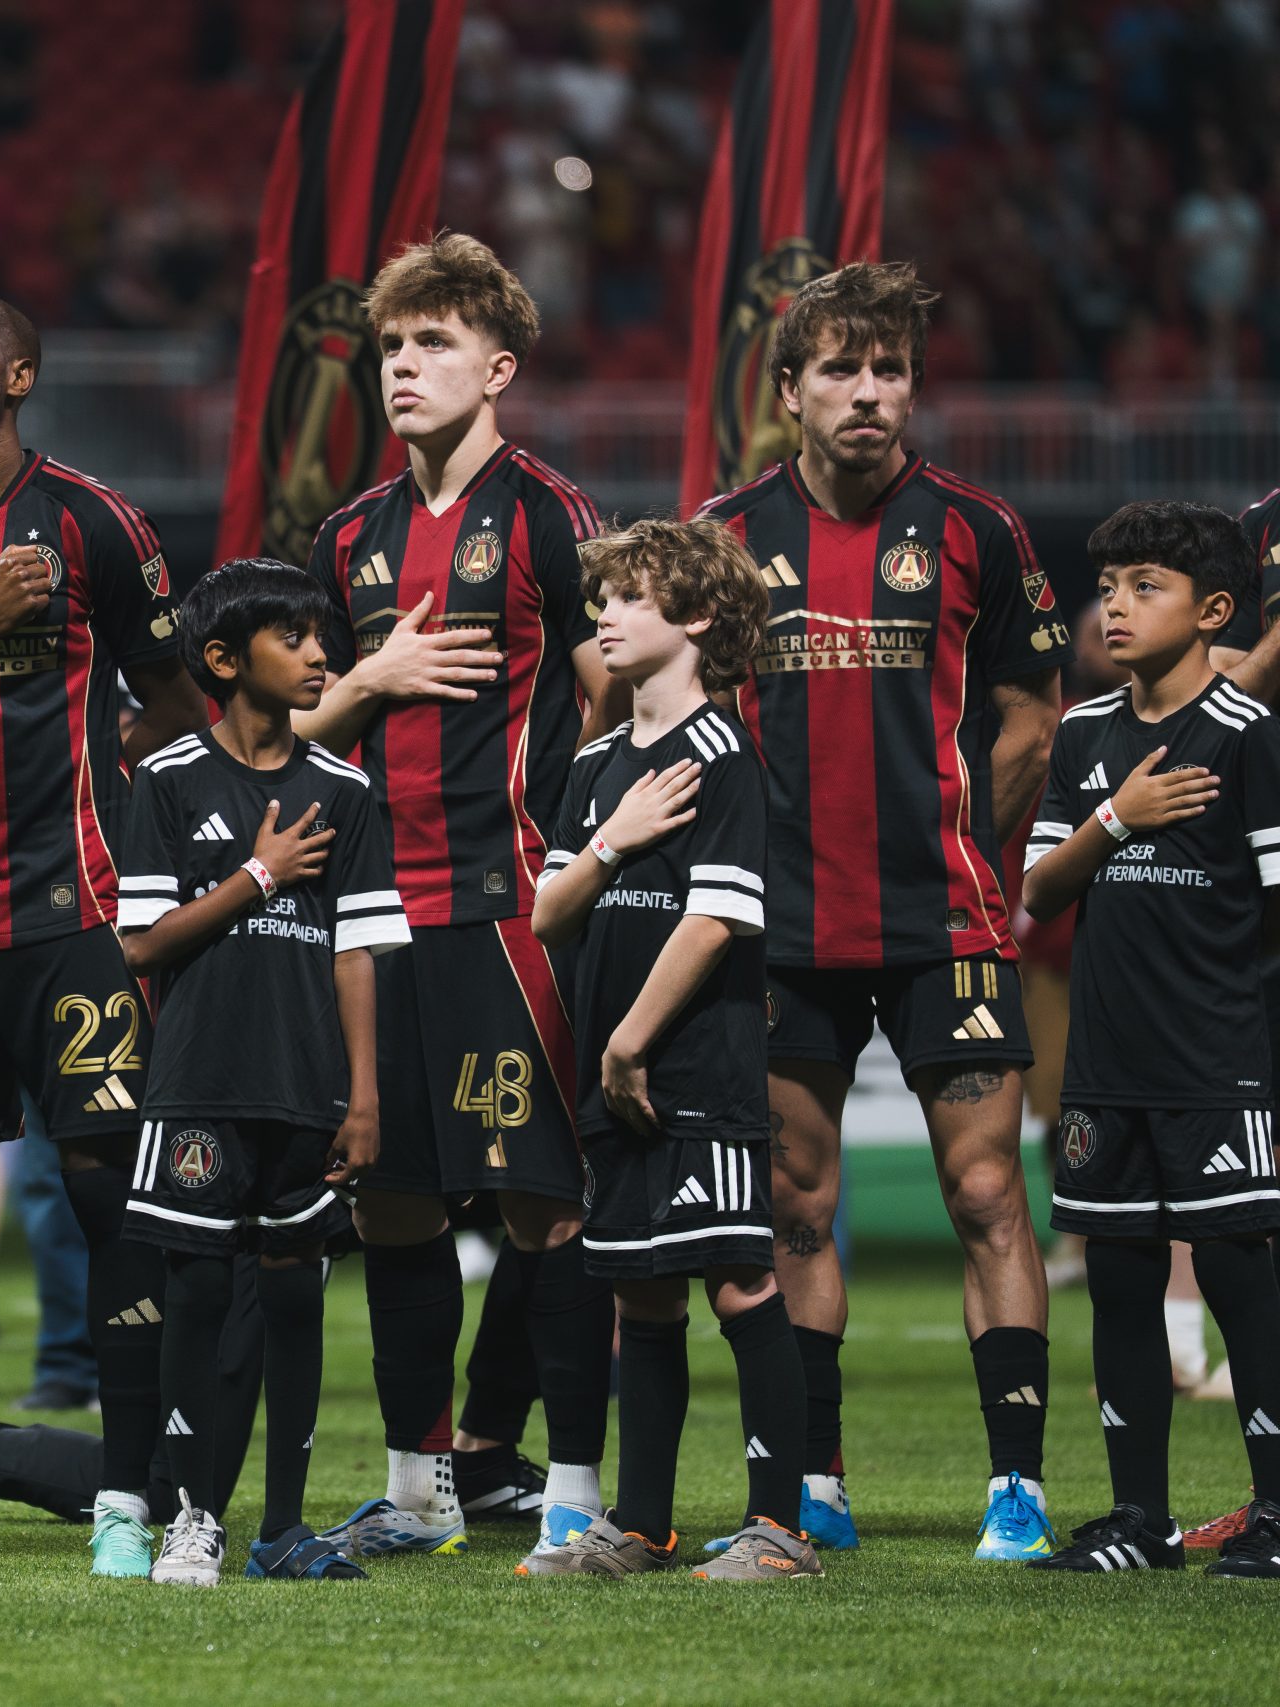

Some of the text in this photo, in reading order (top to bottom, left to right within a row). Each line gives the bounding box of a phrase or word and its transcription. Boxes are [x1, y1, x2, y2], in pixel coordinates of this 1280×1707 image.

[466, 533, 498, 546] ATLANTA
[892, 543, 929, 556] ATLANTA
[144, 562, 160, 576] MLS
[459, 566, 495, 581] UNITED FC
[887, 575, 929, 590] UNITED FC
[1026, 576, 1043, 588] MLS
[764, 631, 928, 654] MERICAN FAMILY
[767, 653, 913, 669] INSURANCE
[1105, 865, 1206, 887] PERMANENTE
[595, 889, 674, 910] RMANENTE
[248, 918, 331, 948] PERMANENT
[54, 991, 143, 1076] 22
[453, 1048, 533, 1129] 48
[178, 1132, 216, 1149] ATLANTA
[172, 1166, 213, 1185] UNITED FC
